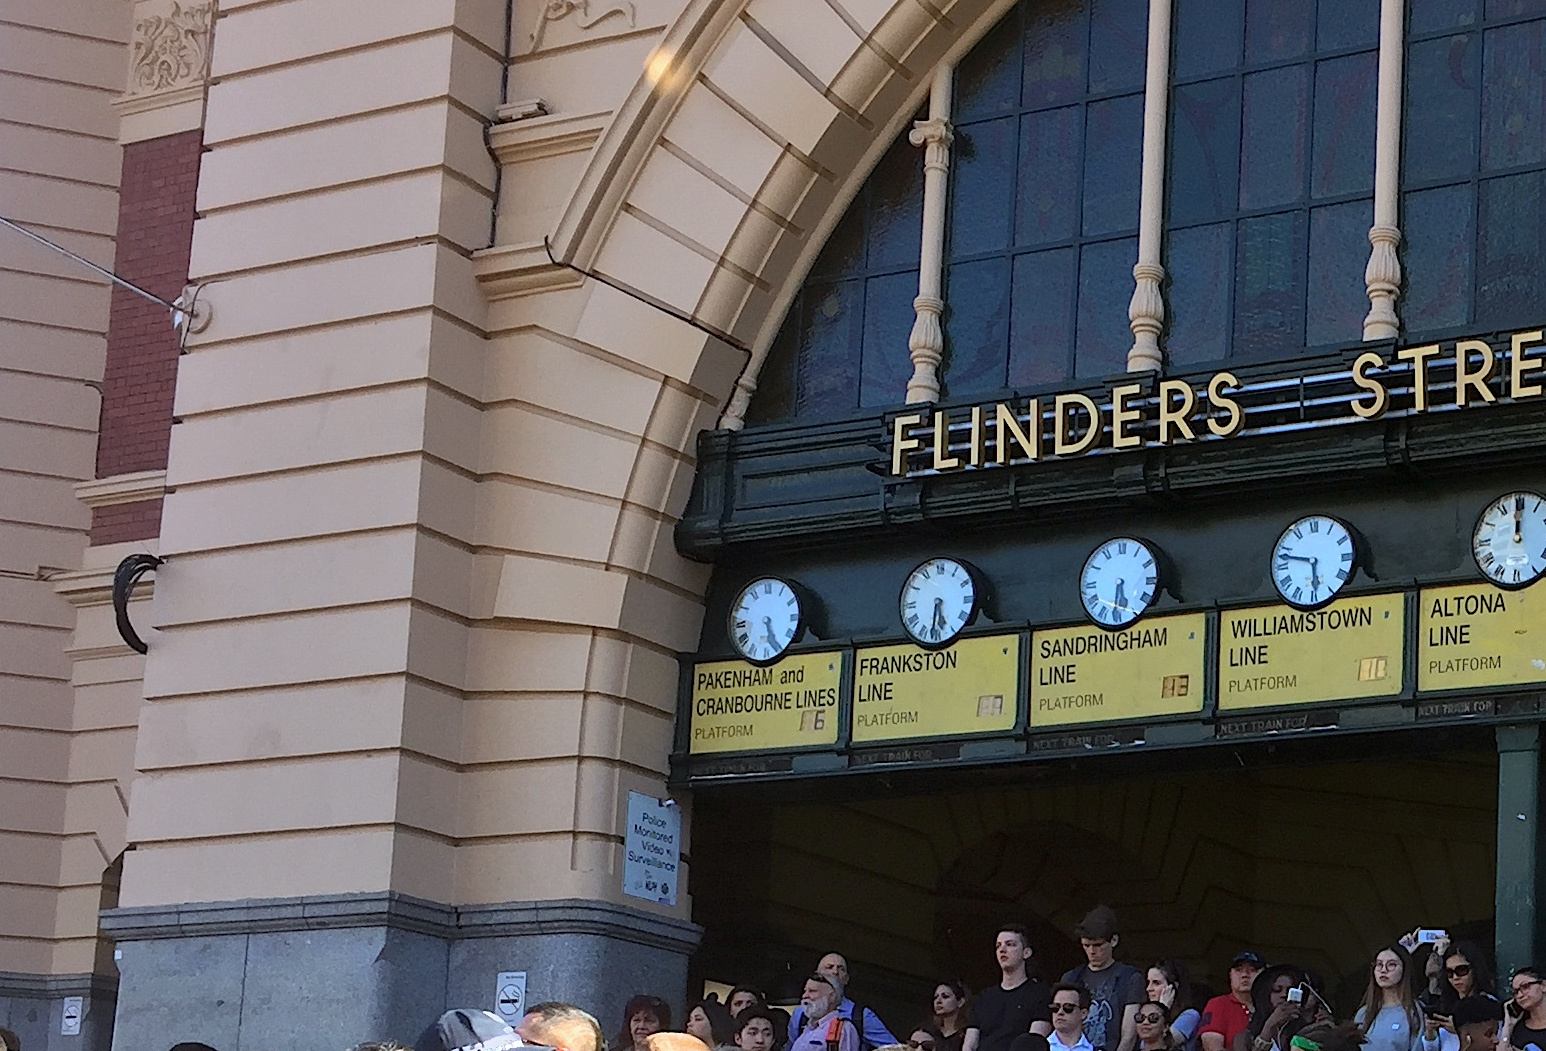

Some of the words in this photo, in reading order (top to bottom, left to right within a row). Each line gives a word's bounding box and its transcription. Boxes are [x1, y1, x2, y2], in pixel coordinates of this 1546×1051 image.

[892, 372, 1243, 476] FLINDERS
[1430, 593, 1506, 618] ALTONA
[1231, 607, 1372, 639] WILLIAMSTOWN
[1040, 628, 1167, 659] SANDRINGHAM
[1429, 624, 1471, 647] LINE
[860, 651, 957, 676] FRANKSTON
[1230, 645, 1269, 667] LINE
[1429, 656, 1502, 674] PLATFORM
[697, 668, 773, 691] PAKENHAM
[780, 665, 805, 684] and
[1040, 665, 1076, 686] LINE
[1228, 675, 1297, 693] PLATFORM
[696, 692, 792, 716] CRANBOURNE
[796, 688, 836, 708] LINES
[858, 682, 893, 702] LINE
[1039, 693, 1103, 711] PLATFORM
[857, 711, 919, 727] PLATFORM
[1220, 722, 1247, 734] NEXT
[1252, 719, 1282, 732] TRAIN
[694, 725, 754, 740] PLATFORM
[642, 812, 667, 828] Police
[641, 840, 664, 856] Video
